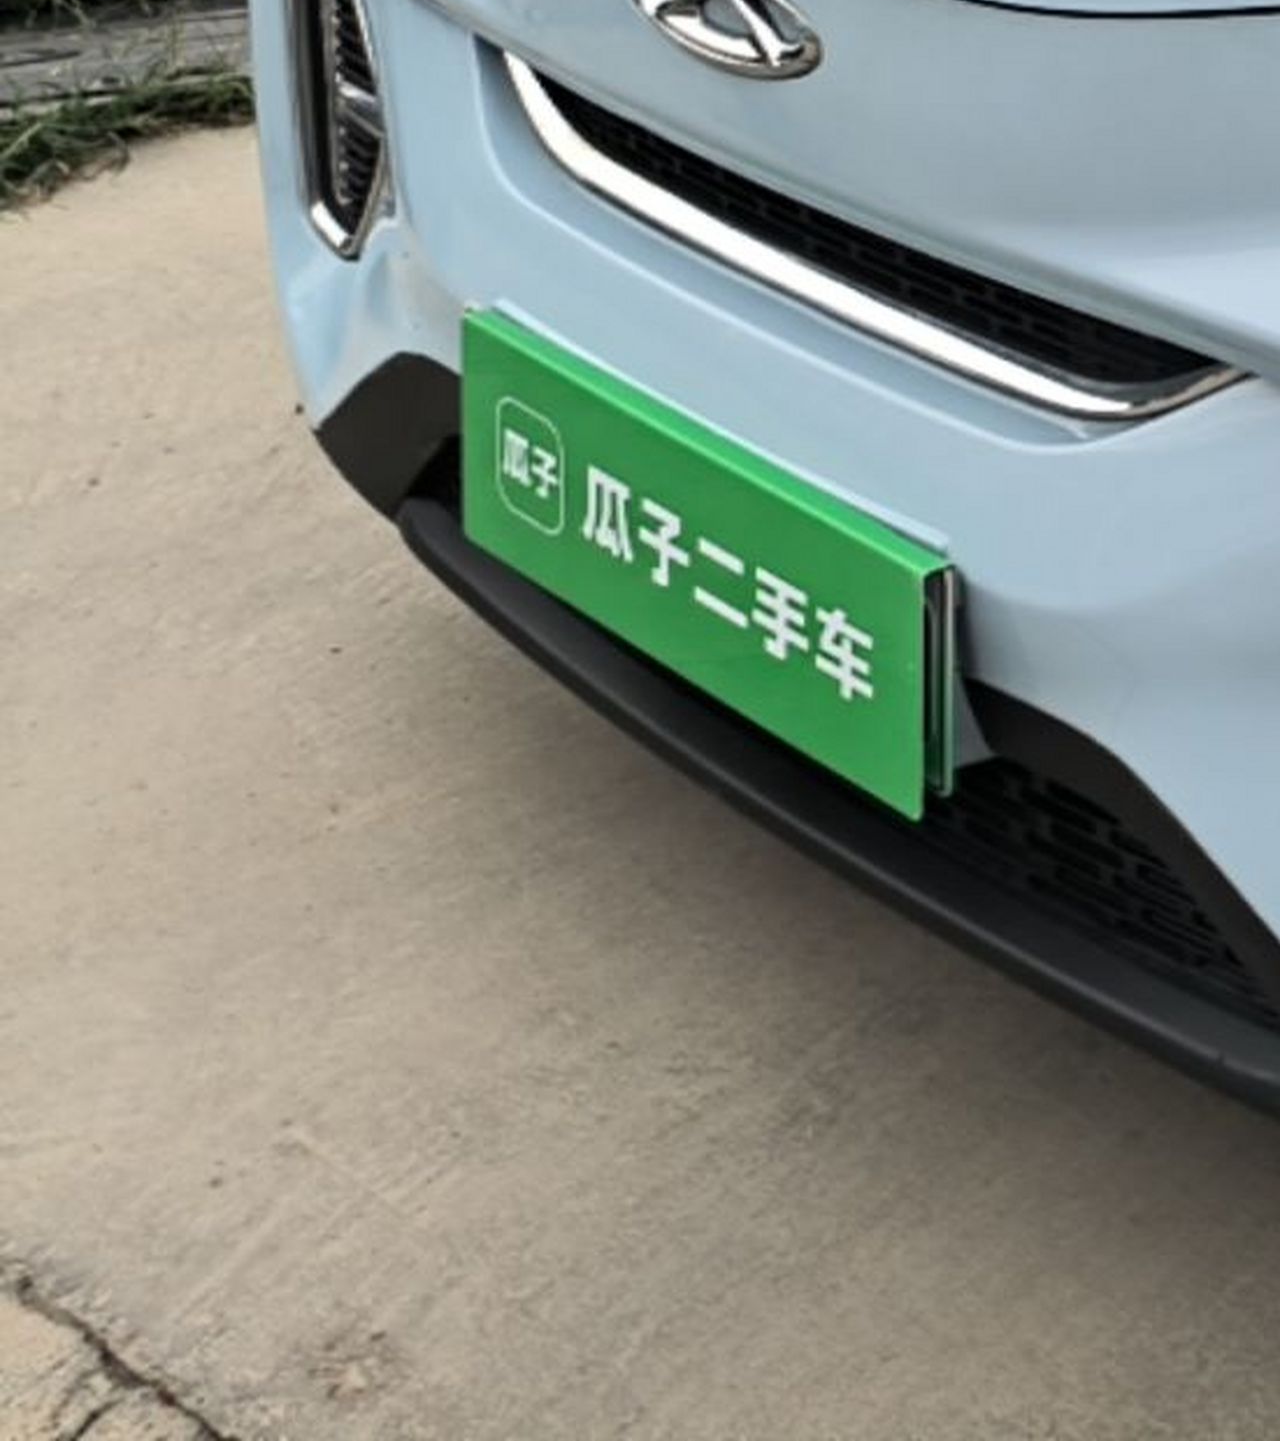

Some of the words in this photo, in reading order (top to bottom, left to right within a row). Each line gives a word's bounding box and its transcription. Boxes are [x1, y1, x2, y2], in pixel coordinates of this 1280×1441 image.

[503, 428, 559, 498] 瓜子
[582, 465, 874, 701] 瓜子二手车
